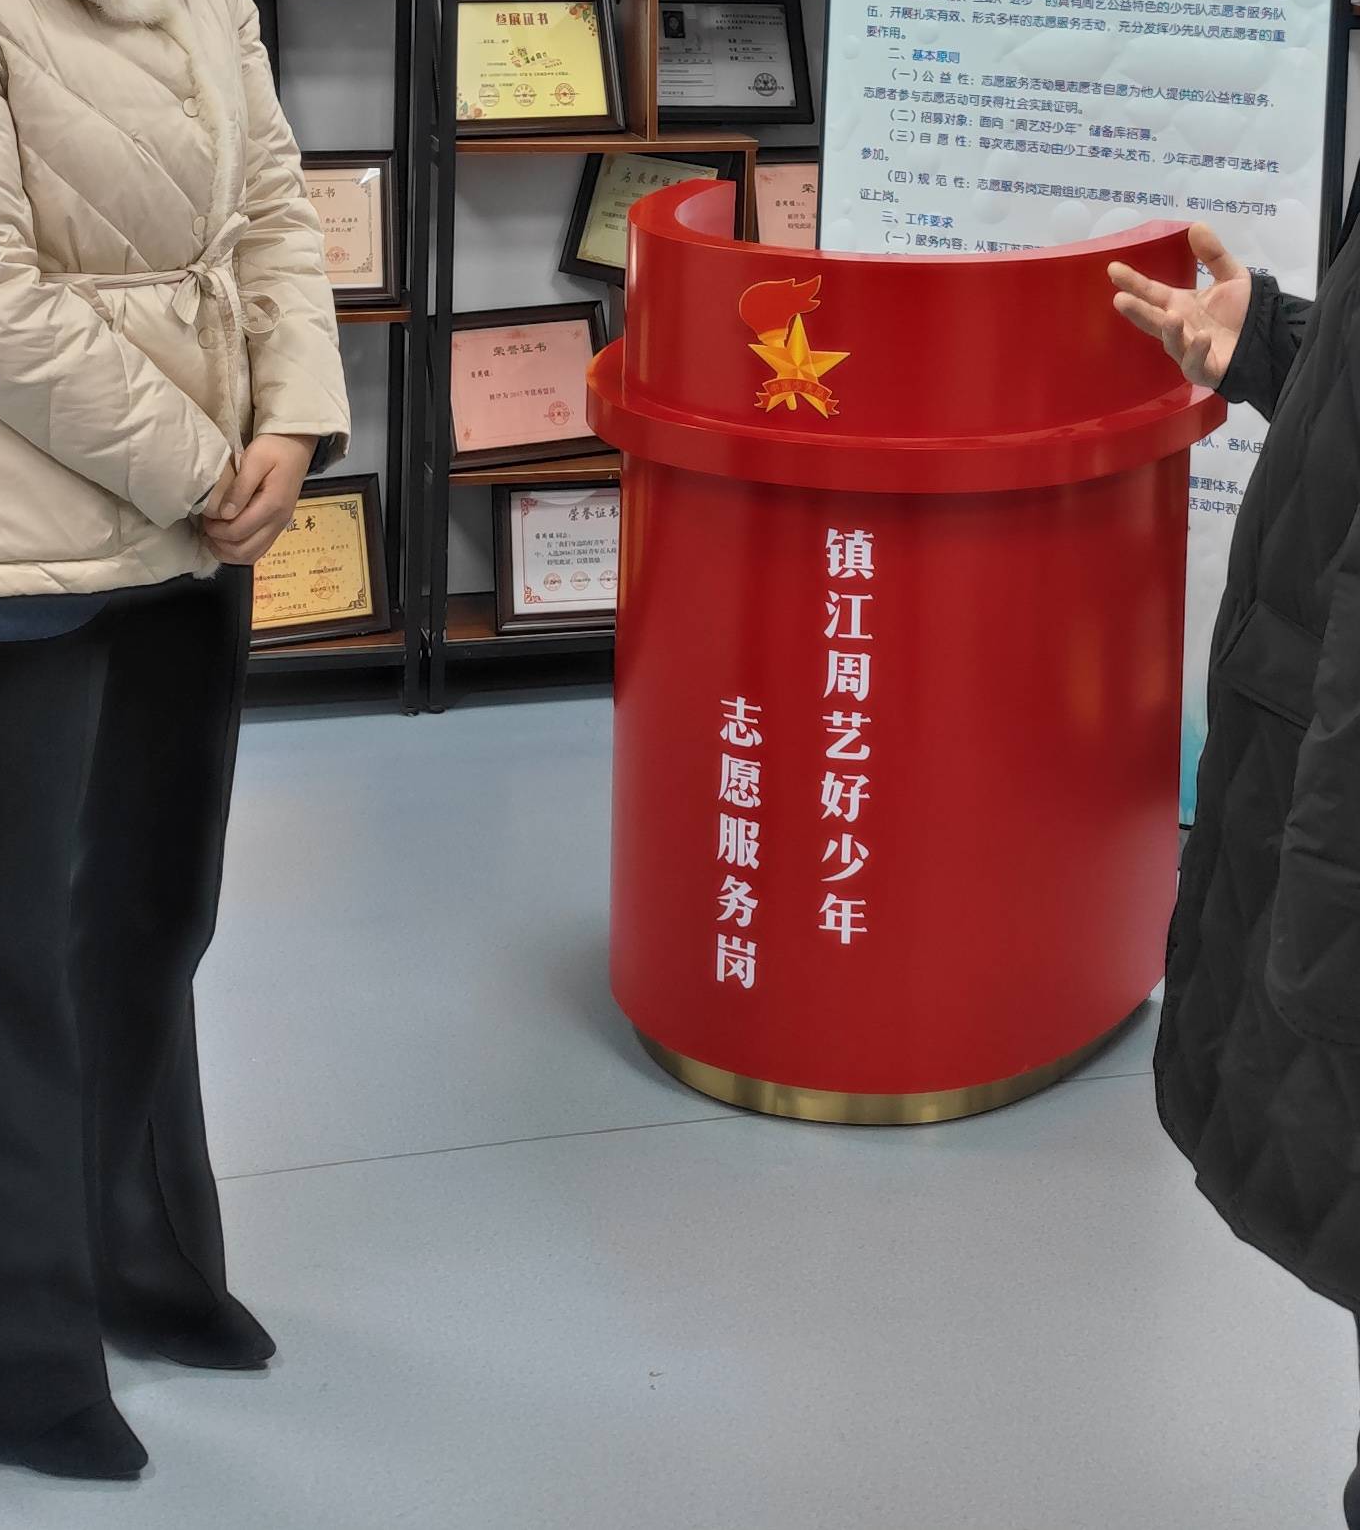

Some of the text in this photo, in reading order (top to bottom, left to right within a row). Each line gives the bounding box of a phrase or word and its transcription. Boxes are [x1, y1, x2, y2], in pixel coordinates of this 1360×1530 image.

[866, 25, 907, 40] 要作用。
[860, 147, 889, 161] 参加。
[859, 188, 900, 204] 证上岗。
[493, 342, 547, 357] 荣誉证书
[568, 506, 619, 521] 荣誉证书
[816, 527, 877, 945] 镇江周艺好少年
[713, 696, 763, 990] 志愿服务岗
